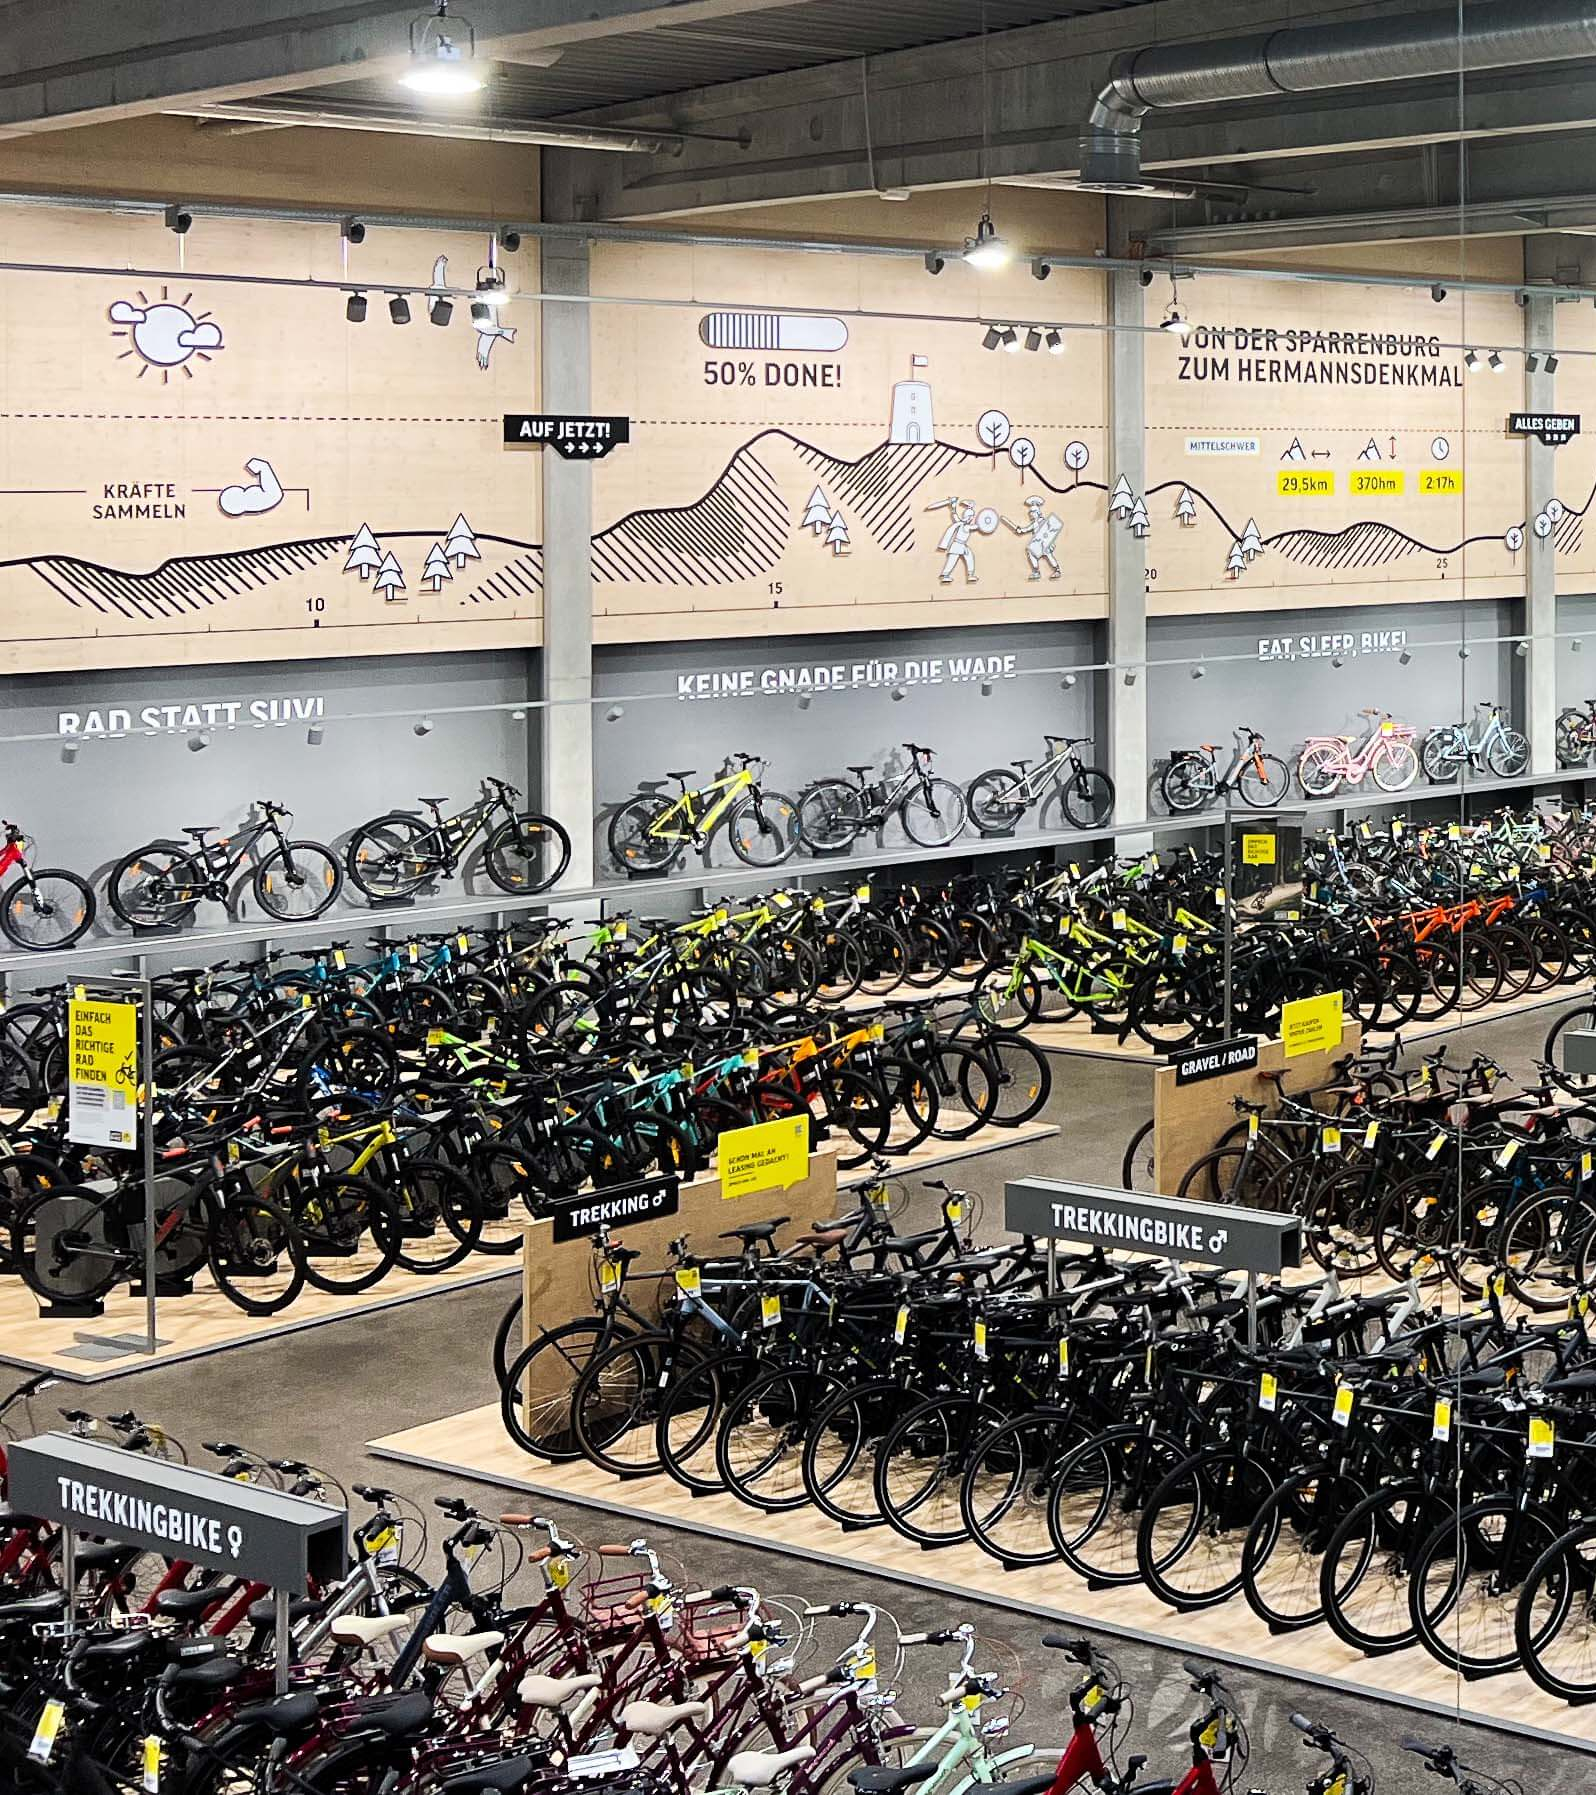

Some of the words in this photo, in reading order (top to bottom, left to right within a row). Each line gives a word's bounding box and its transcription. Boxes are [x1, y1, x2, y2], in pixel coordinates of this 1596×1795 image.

[1235, 328, 1277, 352] DER
[1285, 330, 1440, 357] SPARRENBURG
[703, 361, 756, 386] 50%
[765, 362, 842, 387] DONE!
[1178, 356, 1229, 381] ZUM
[1238, 358, 1464, 387] HERMANNSDENKMAL
[520, 421, 553, 438] AUF
[557, 421, 611, 439] JETZT!
[1515, 418, 1543, 431] ALLES
[1545, 418, 1575, 431] GEBEN
[1190, 440, 1256, 451] MITTELSCHWER
[103, 480, 176, 499] KRÄFTE
[1282, 476, 1328, 492] 29,5km
[1356, 476, 1396, 490] 370hm
[92, 504, 186, 520] SAMMELN
[1436, 558, 1448, 569] 25
[768, 582, 783, 594] 15
[306, 597, 325, 612] 10
[677, 671, 755, 700] KEINE
[760, 665, 846, 694] GNADE
[851, 659, 899, 689] FÜR
[904, 660, 943, 686] DIE
[949, 655, 1017, 683] WADE
[58, 709, 132, 741] RAD
[140, 701, 242, 737] STATT
[75, 1009, 111, 1024] EINFACH
[75, 1025, 93, 1037] DAS
[75, 1039, 115, 1054] RICHTIGE
[75, 1054, 94, 1065] RAD
[1181, 1056, 1220, 1076] GRAVEL
[1228, 1046, 1256, 1064] ROAD
[75, 1068, 107, 1082] FINDEN
[570, 1193, 650, 1228] TREKKING
[1051, 1203, 1203, 1252] TREKKINGBIKE
[58, 1477, 222, 1553] TREKKINGBIKE
